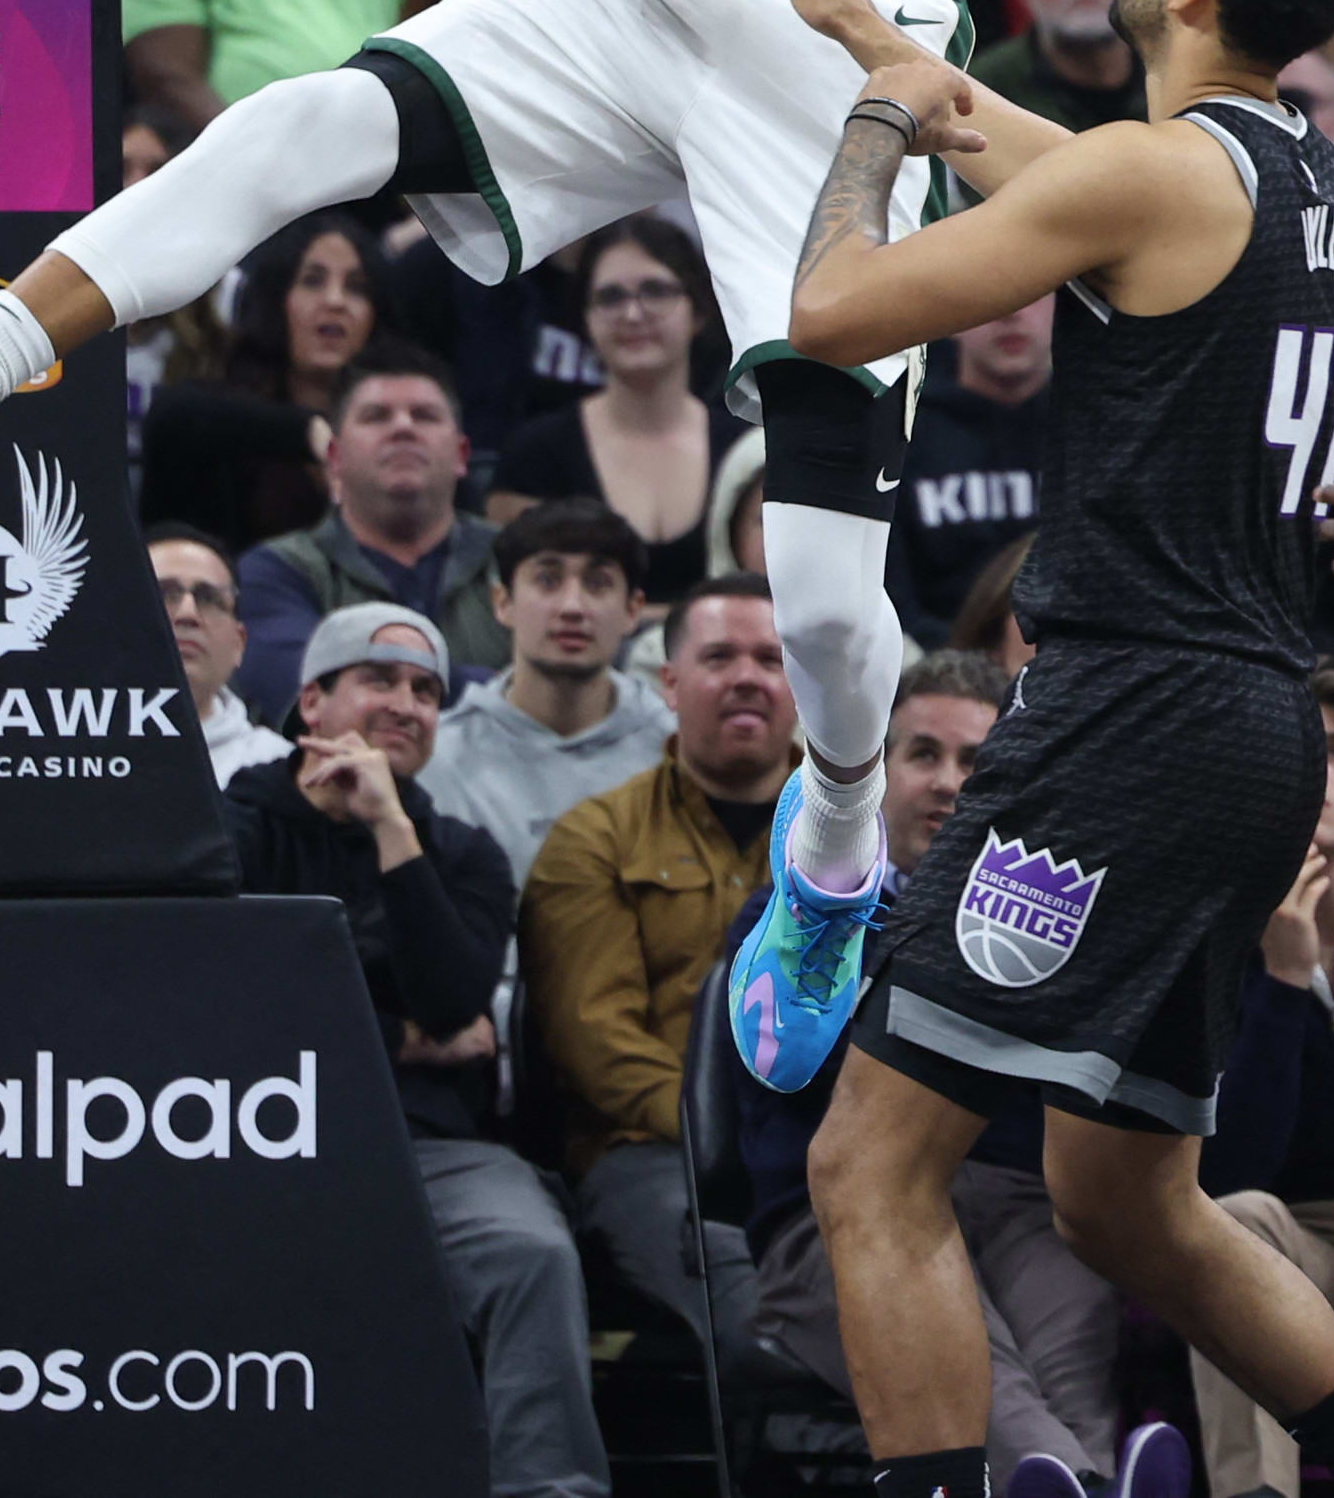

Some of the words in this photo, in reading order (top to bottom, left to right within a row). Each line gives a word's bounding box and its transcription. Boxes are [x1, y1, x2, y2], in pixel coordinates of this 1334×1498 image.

[917, 469, 1034, 527] KIN
[964, 885, 1079, 949] KINGS
[978, 868, 1084, 916] SACRAMENTO
